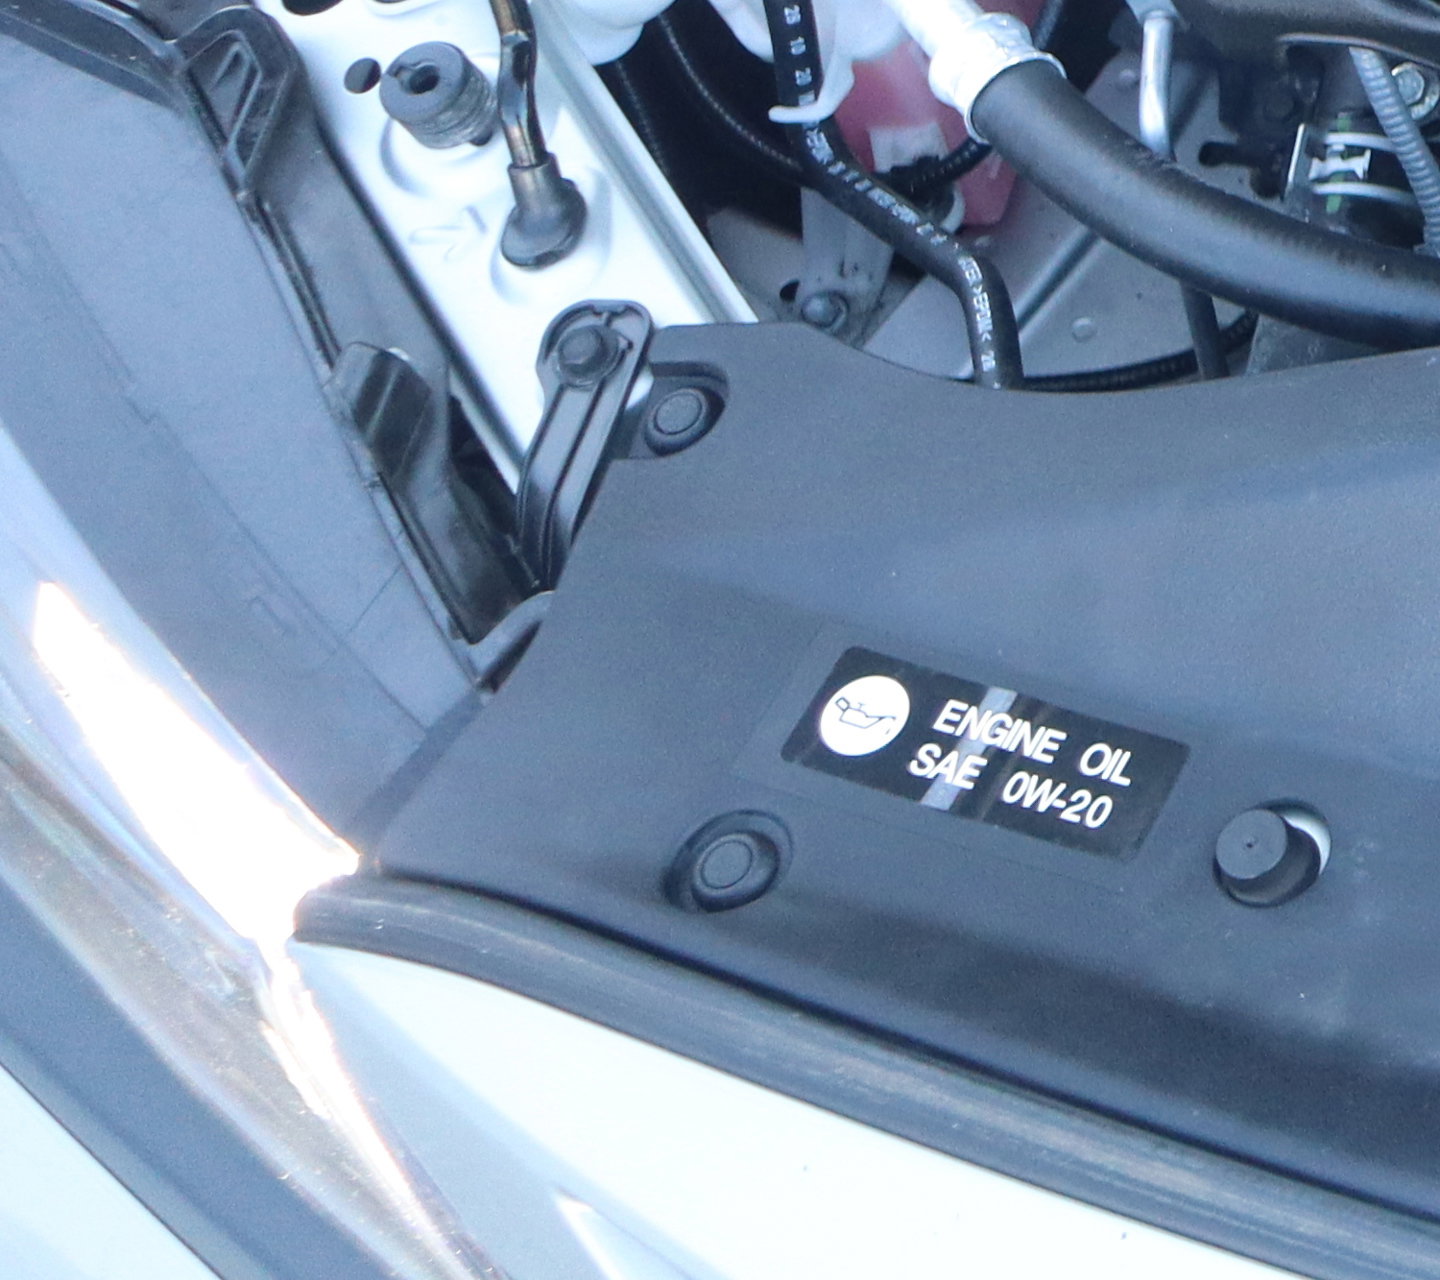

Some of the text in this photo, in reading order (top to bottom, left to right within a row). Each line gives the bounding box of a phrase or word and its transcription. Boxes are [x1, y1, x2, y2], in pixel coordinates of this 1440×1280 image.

[909, 743, 1113, 829] SAE 0W-20
[932, 700, 1132, 787] ENGINE OIL
